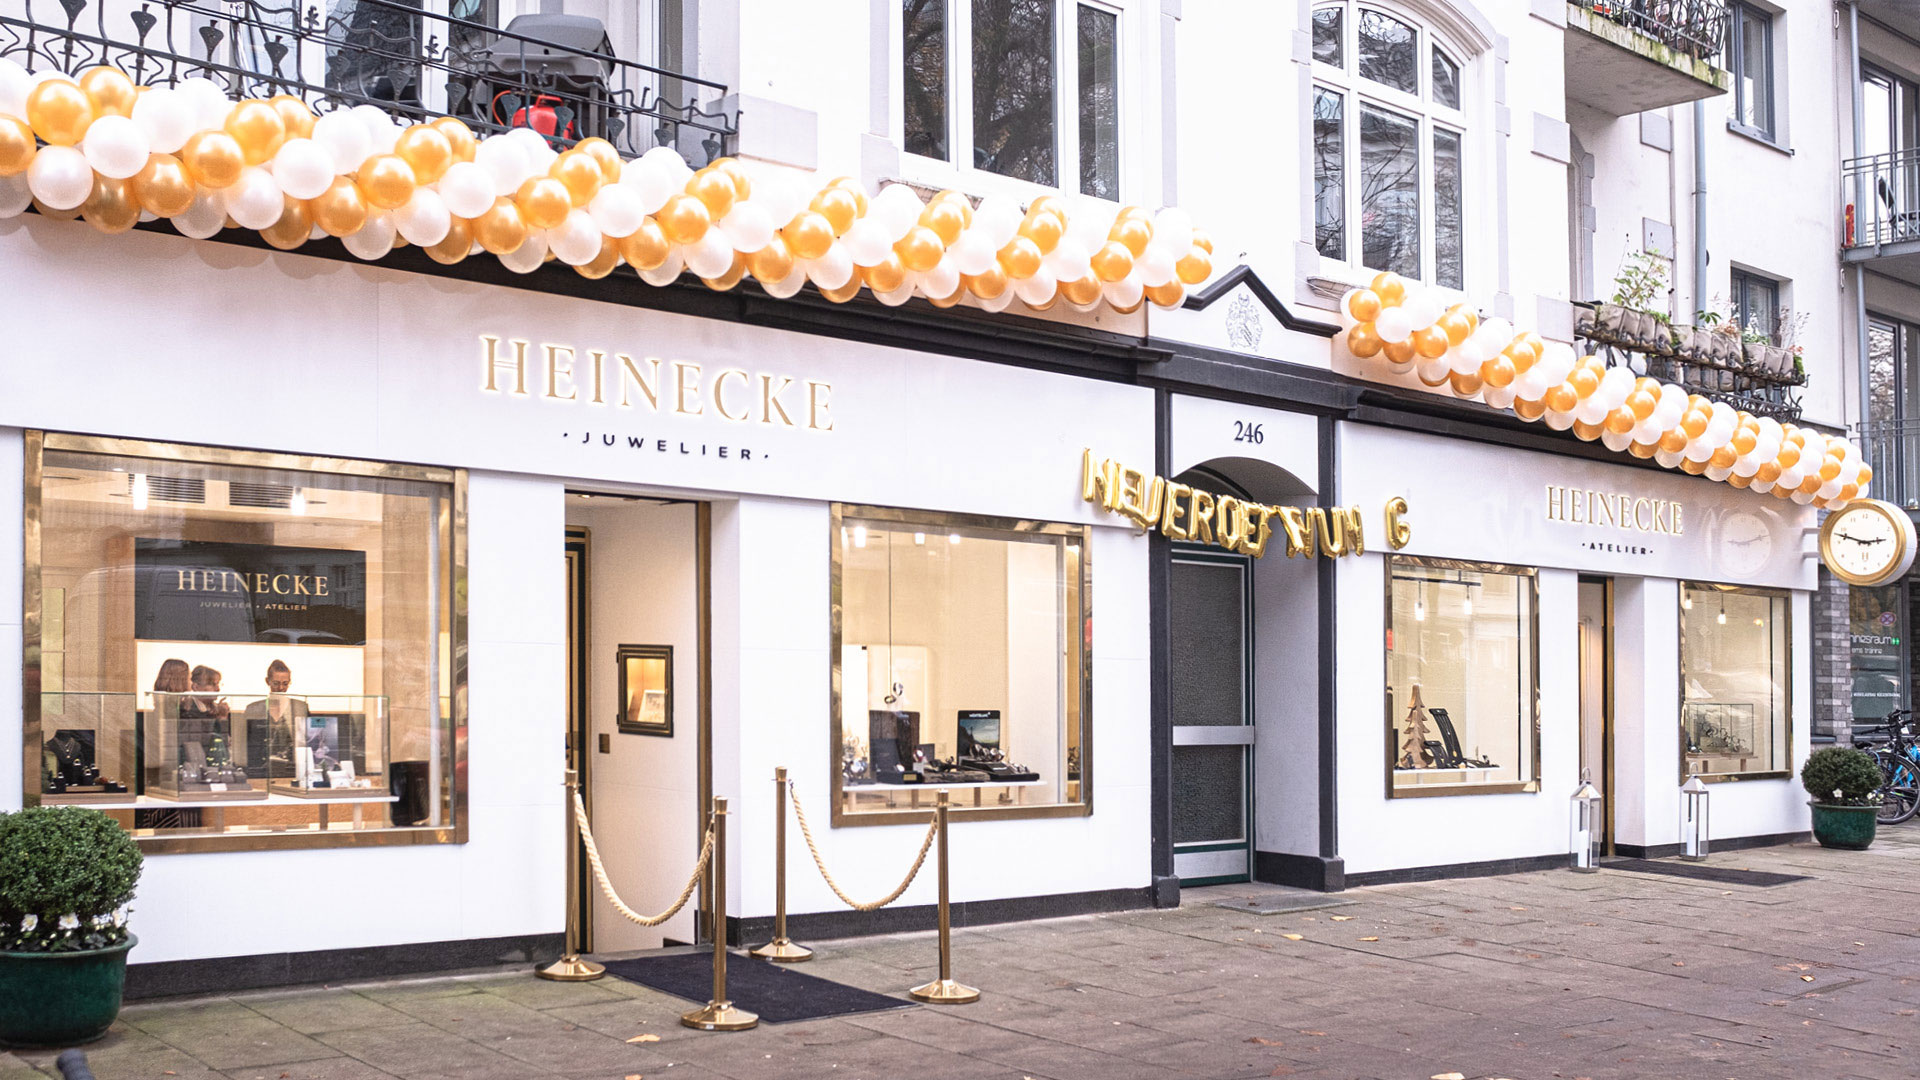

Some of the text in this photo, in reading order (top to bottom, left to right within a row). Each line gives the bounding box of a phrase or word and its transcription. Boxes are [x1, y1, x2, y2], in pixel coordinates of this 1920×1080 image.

[482, 335, 834, 432] HEINECKE
[1233, 420, 1264, 444] 246
[582, 432, 751, 460] JUWELIER
[1546, 485, 1684, 535] HEINECKE
[1589, 542, 1646, 555] ATELIER
[177, 570, 329, 596] HEINECKE
[264, 603, 308, 611] ATELIER
